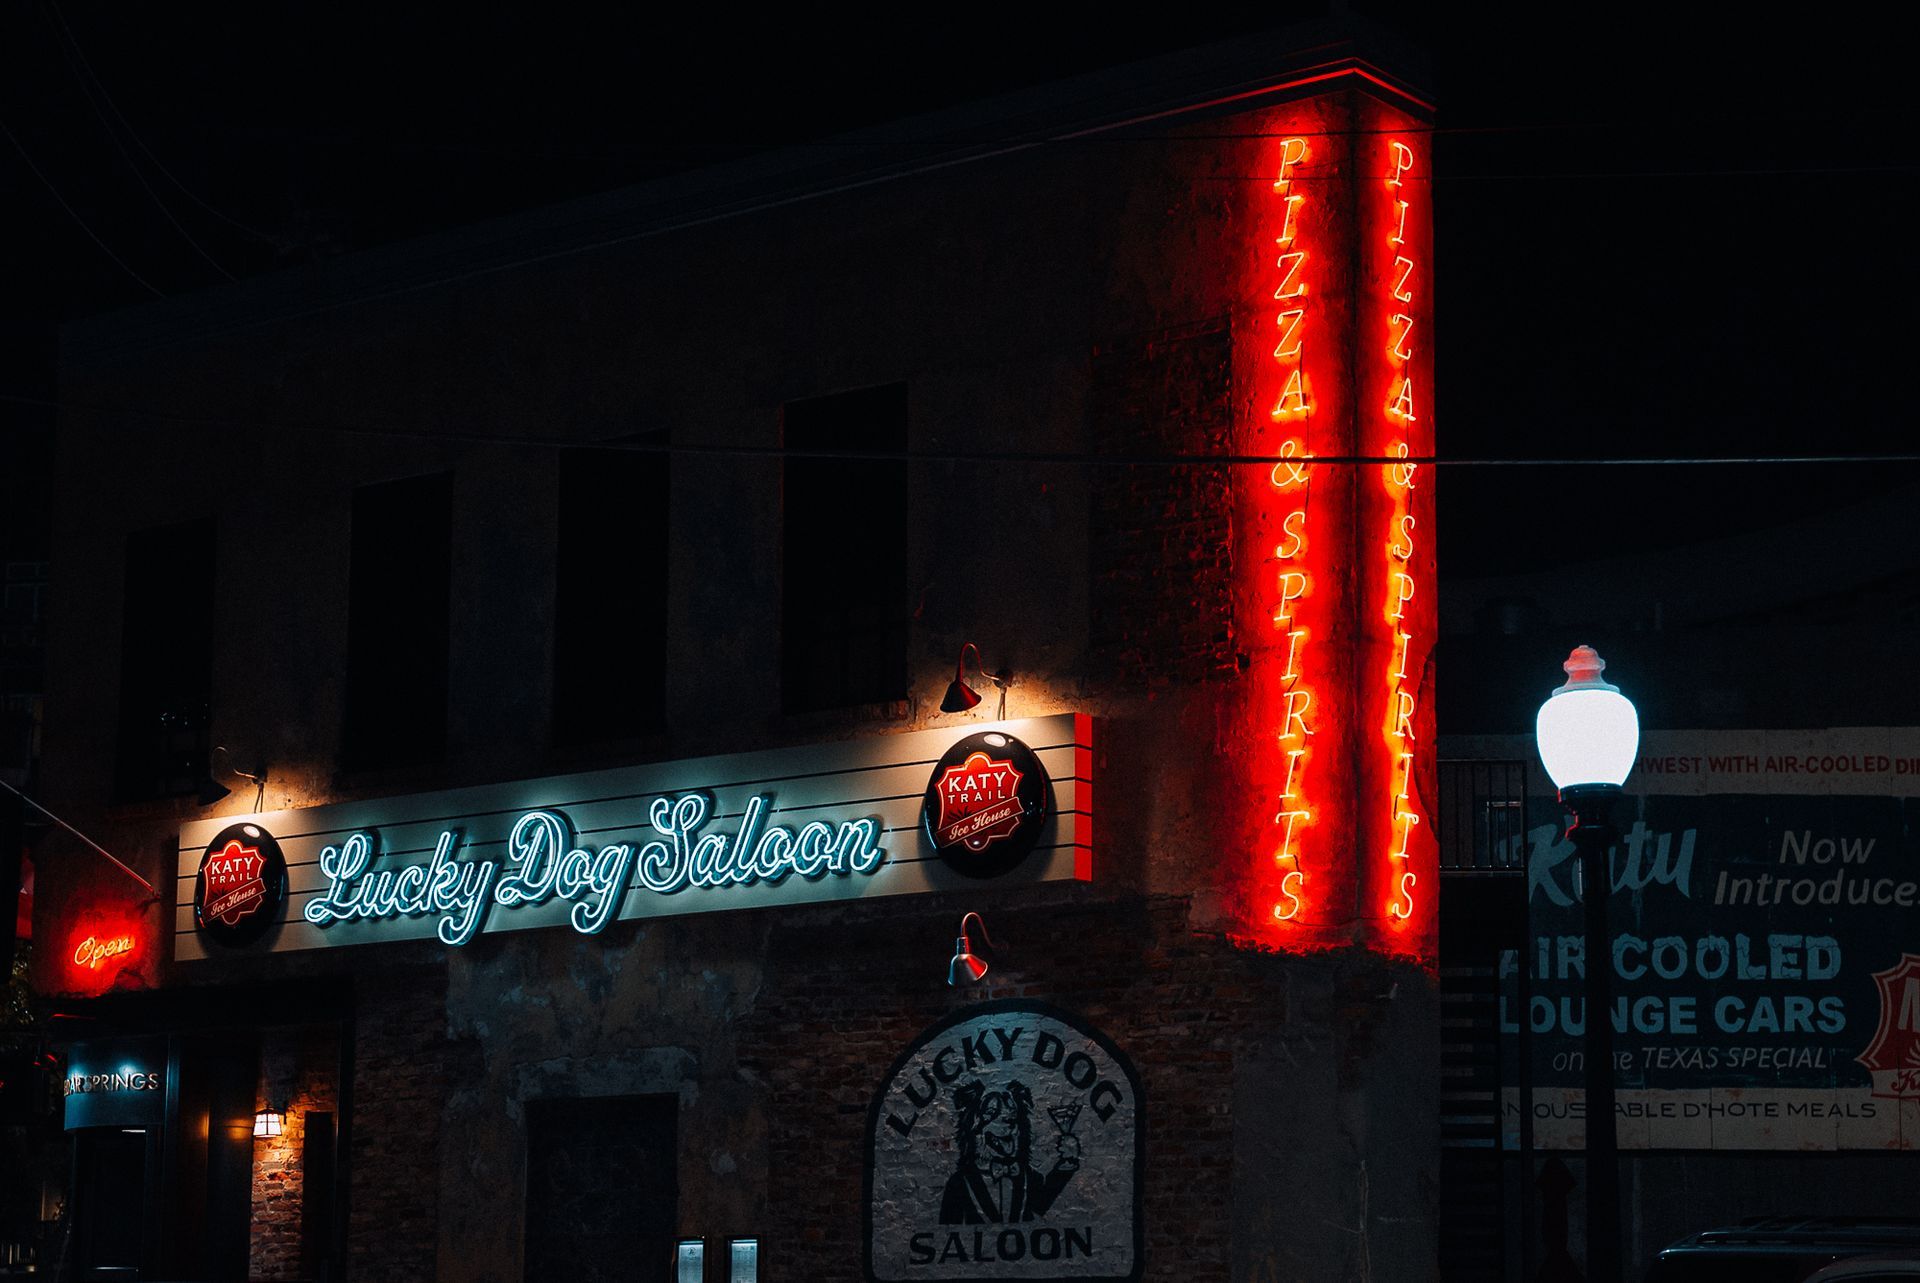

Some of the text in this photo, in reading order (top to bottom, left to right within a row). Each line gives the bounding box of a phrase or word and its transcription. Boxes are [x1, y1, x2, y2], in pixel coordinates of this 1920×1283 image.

[1271, 138, 1314, 920] PIZZA & SPIRITS
[1390, 142, 1419, 919] PIZZA & SPIRITS
[1708, 756, 1759, 774] WITH
[1764, 755, 1890, 774] AIR-COOLED
[1894, 757, 1920, 775] DI
[948, 771, 1007, 804] KATY TRAIL
[949, 806, 1012, 840] Ice House
[1778, 829, 1877, 865] Now
[210, 856, 254, 885] KATY TRAIL
[304, 792, 883, 946] Lucky Dog Saloon
[210, 886, 257, 916] Ice House
[1713, 869, 1920, 907] Introduce
[74, 936, 132, 969] Open
[1611, 931, 1842, 981] COOLED
[1714, 994, 1848, 1035] CARS
[1552, 1050, 1585, 1072] on
[1641, 1046, 1720, 1070] TEXAS
[1725, 1046, 1828, 1070] SPECIAL
[83, 1072, 160, 1093] SPRINGS
[886, 1026, 1124, 1138] LUCKY DOG
[1612, 1102, 1677, 1118] ABLE
[1683, 1102, 1780, 1118] D'HOTE
[1787, 1102, 1877, 1118] MEALS
[908, 1226, 1093, 1265] SALOON
